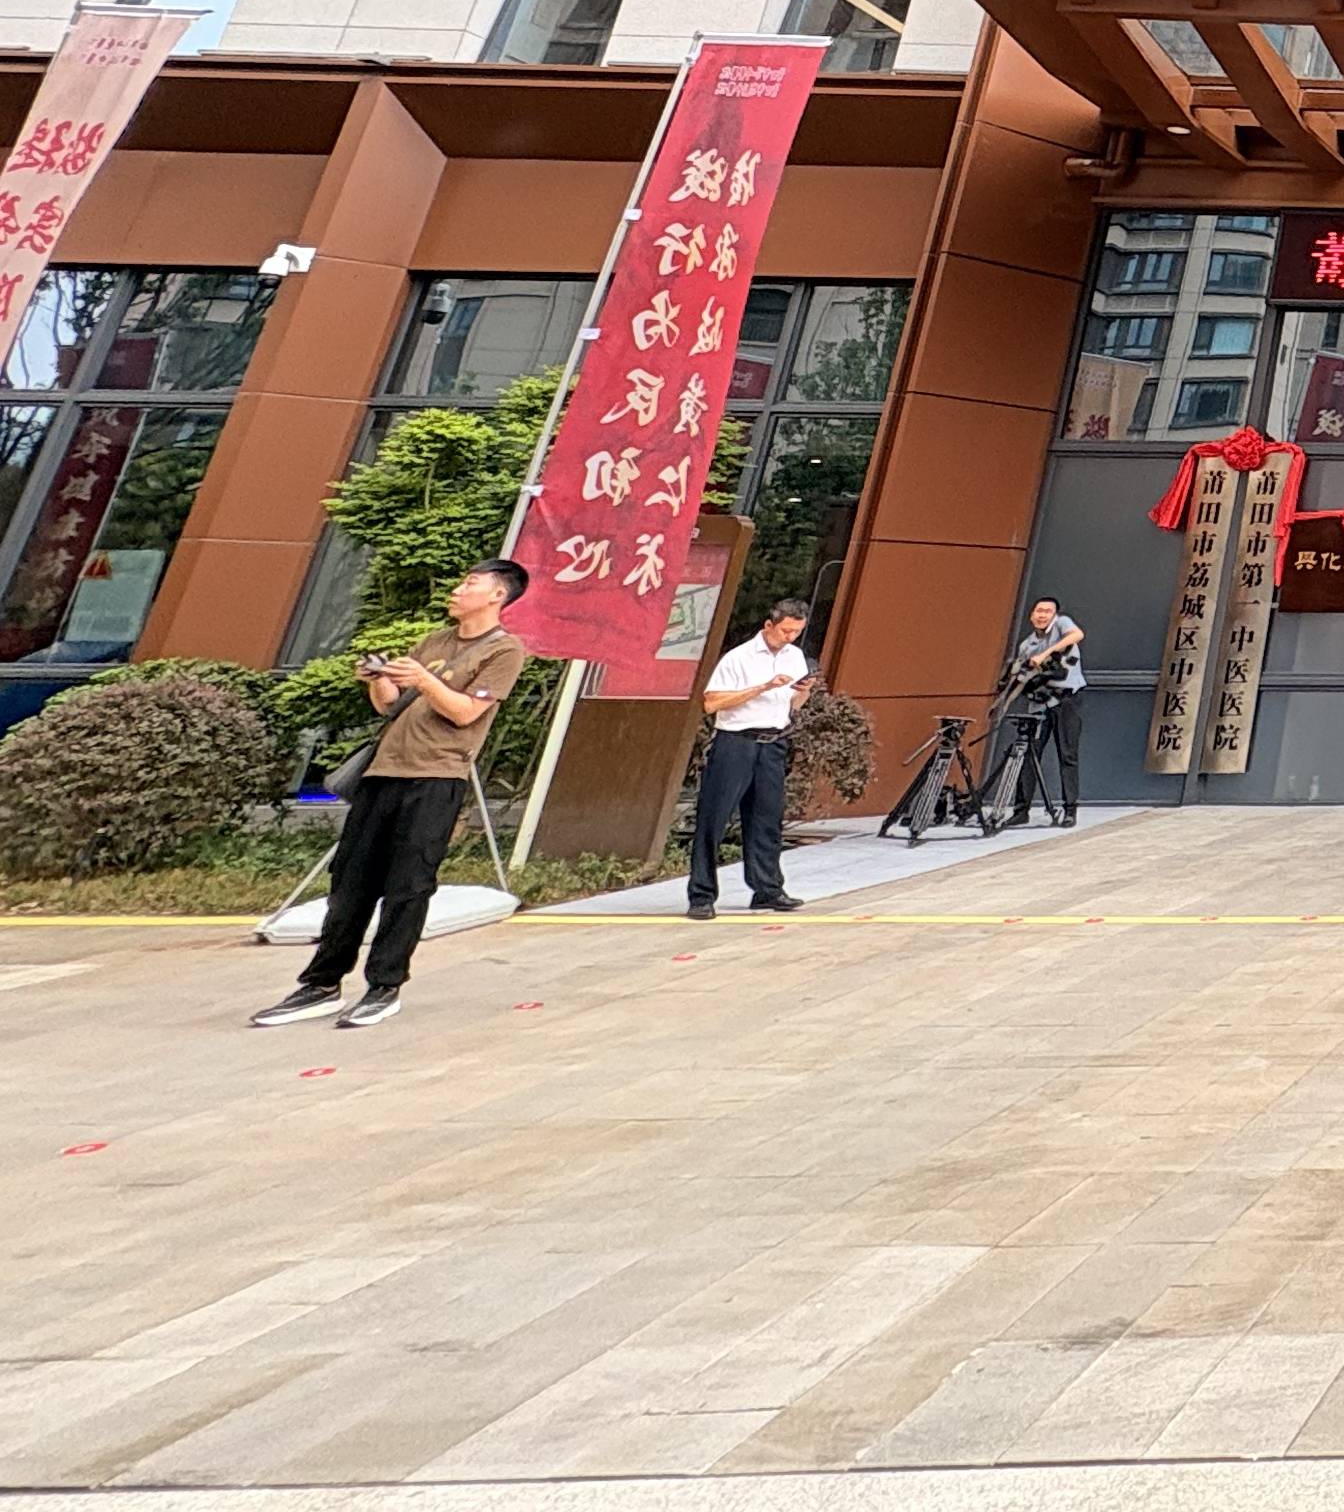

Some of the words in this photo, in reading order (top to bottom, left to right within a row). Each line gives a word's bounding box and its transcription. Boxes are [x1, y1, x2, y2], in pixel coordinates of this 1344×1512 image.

[1156, 470, 1228, 752] 莆田市荔城区中医院
[1212, 470, 1281, 752] 莆田市第一中医医院
